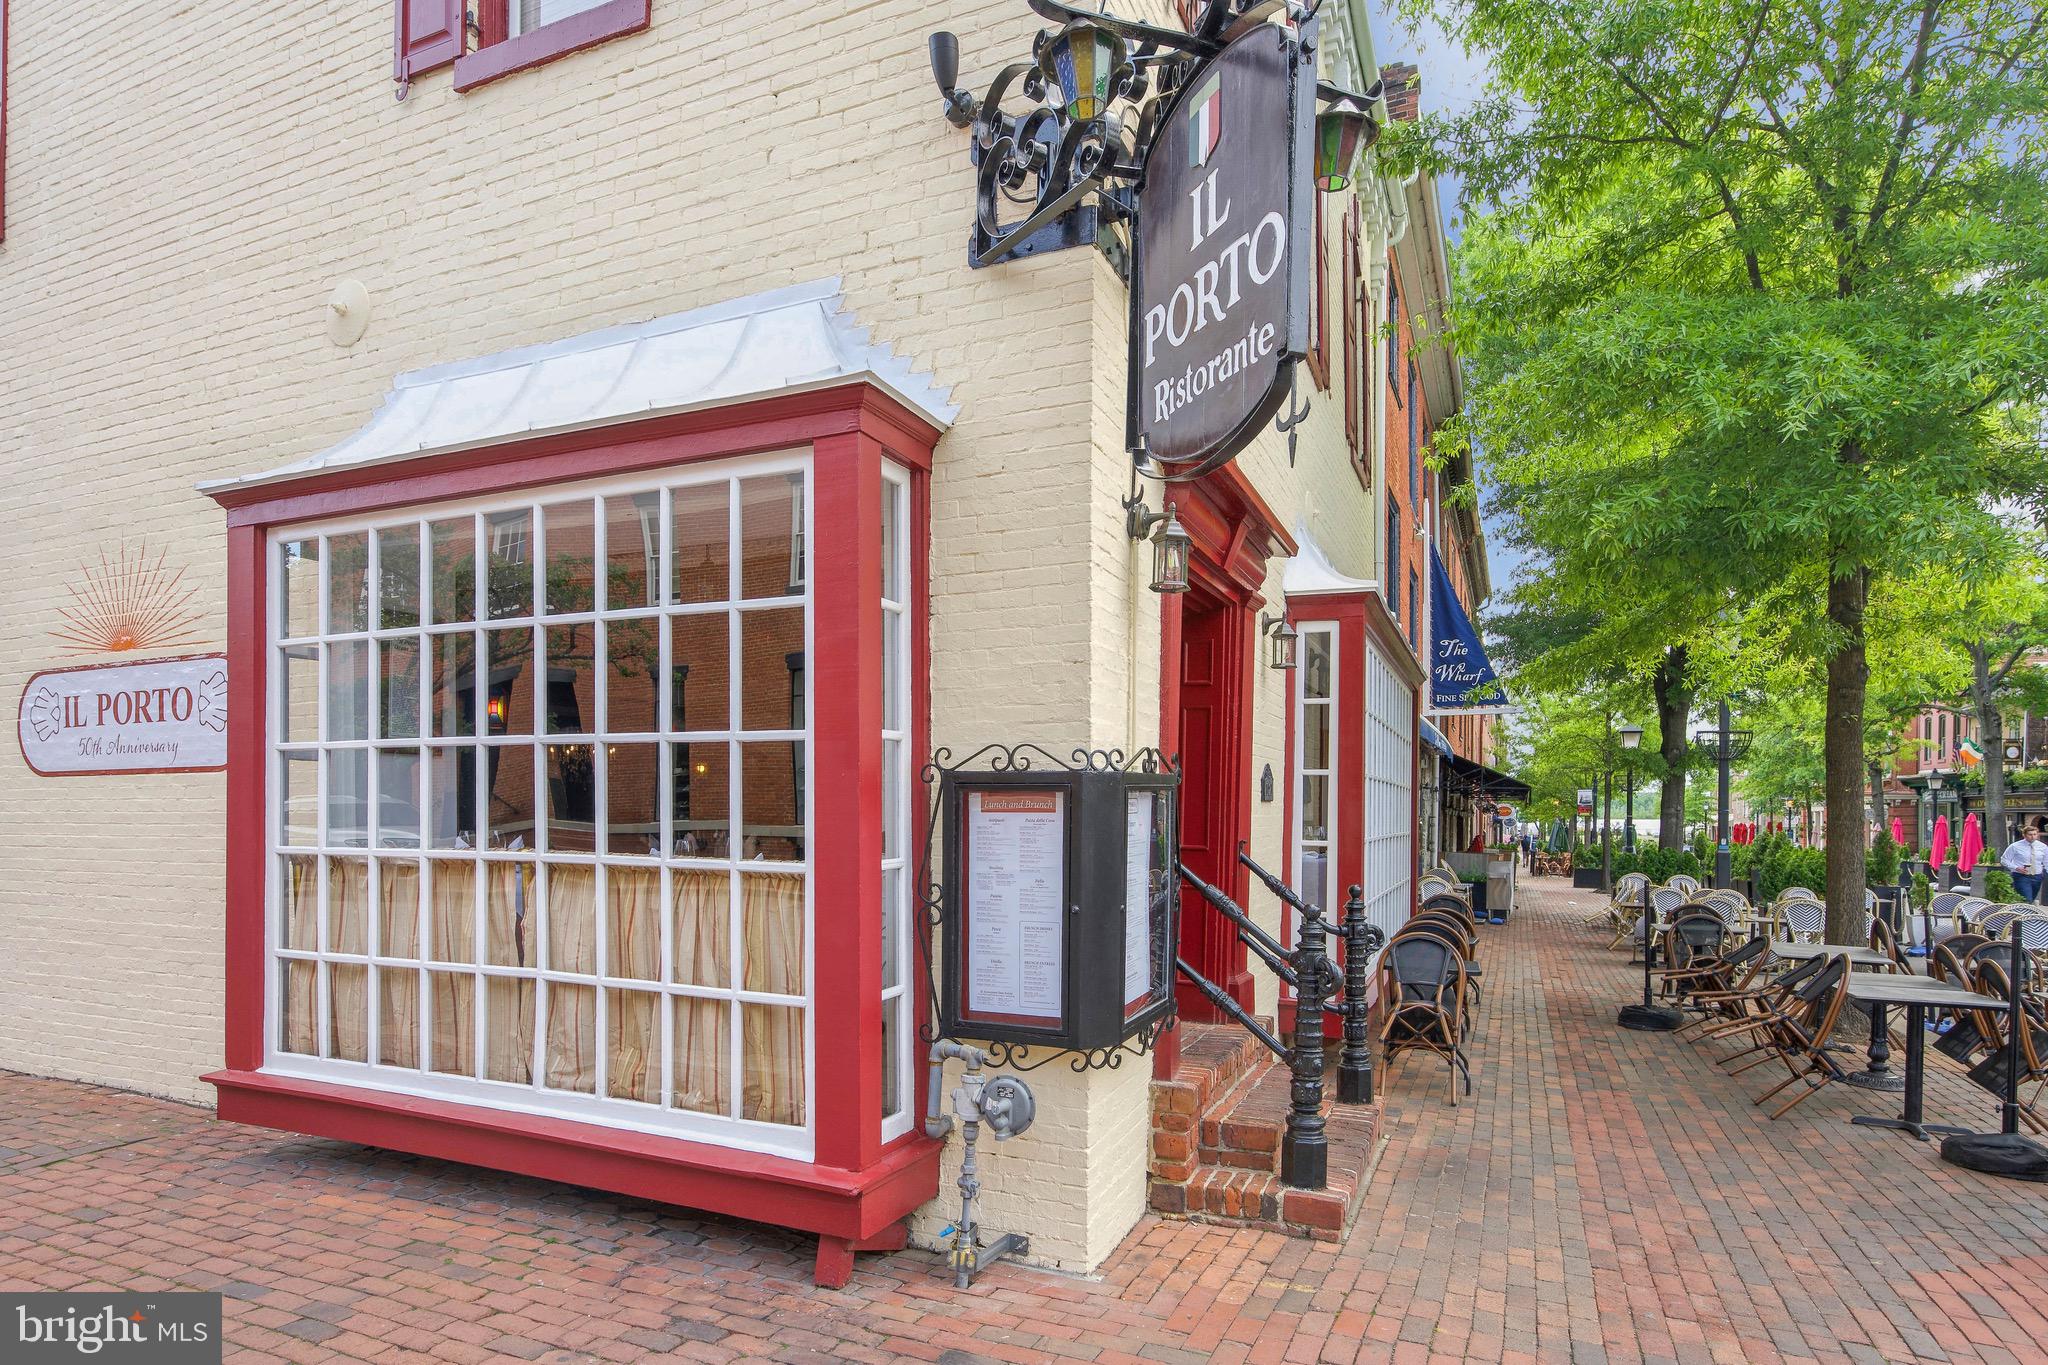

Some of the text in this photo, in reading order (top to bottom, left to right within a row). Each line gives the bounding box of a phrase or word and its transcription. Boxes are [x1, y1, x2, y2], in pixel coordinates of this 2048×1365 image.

[1188, 166, 1231, 253] IL
[1143, 210, 1287, 369] PORTO
[1153, 319, 1275, 424] Ristorante
[1438, 638, 1469, 658] The
[1435, 662, 1486, 686] Wharf
[63, 686, 194, 729] IL PORTO
[1436, 694, 1457, 703] FINE
[77, 733, 180, 766] 50th Anniversary
[984, 799, 1053, 809] Lunch and Brunch
